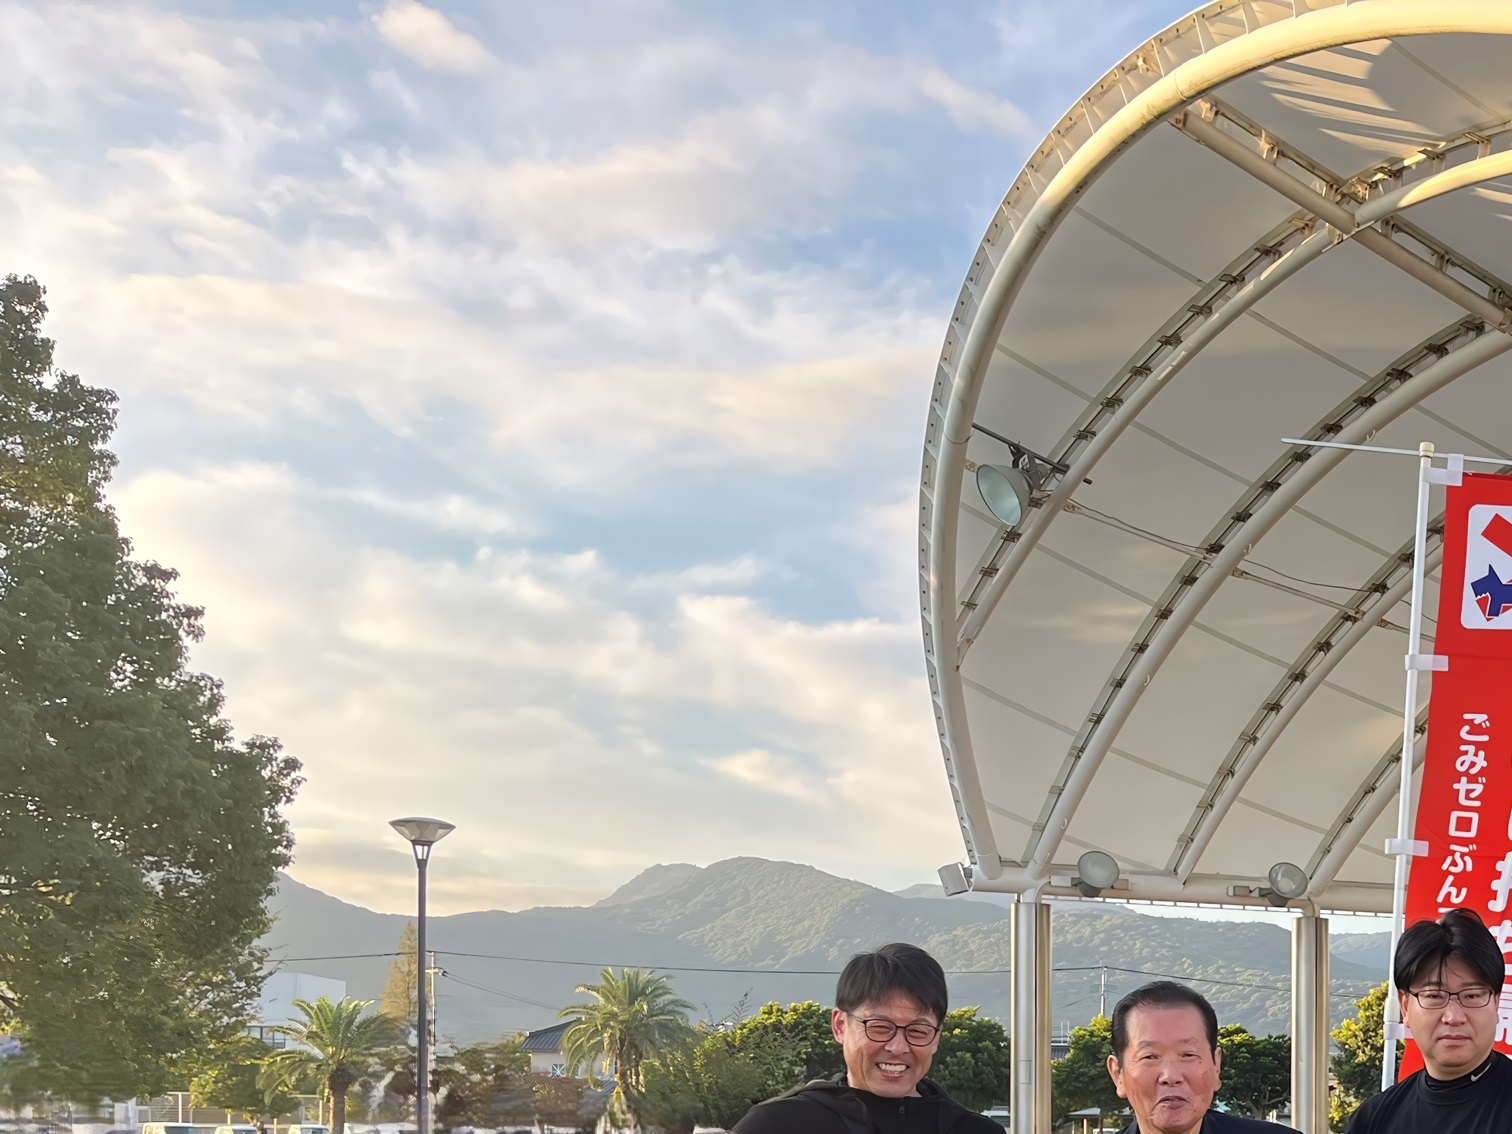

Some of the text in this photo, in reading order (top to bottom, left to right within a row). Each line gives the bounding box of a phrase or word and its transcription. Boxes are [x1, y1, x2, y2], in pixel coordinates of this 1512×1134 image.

[1436, 713, 1491, 925] ごみゼロぶん
